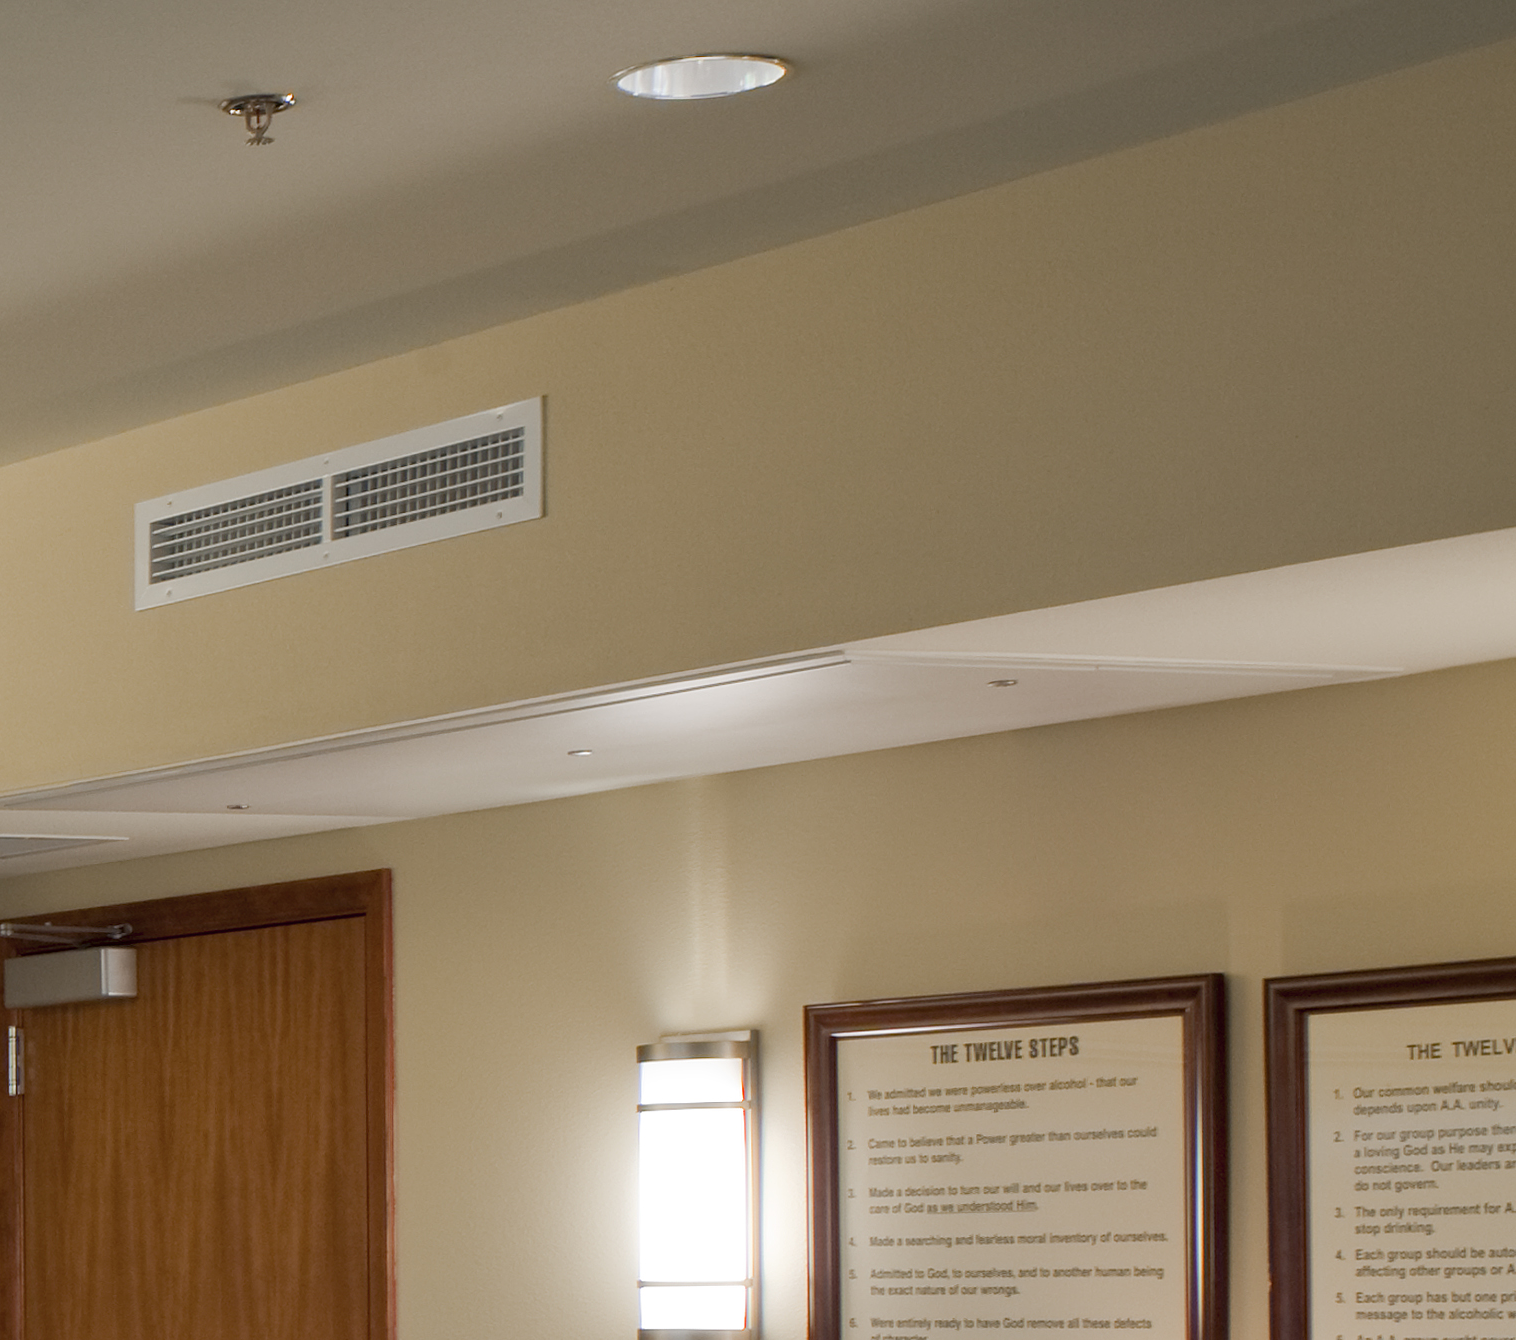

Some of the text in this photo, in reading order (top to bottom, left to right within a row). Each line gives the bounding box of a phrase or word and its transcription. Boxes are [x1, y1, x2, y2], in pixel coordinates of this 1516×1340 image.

[931, 1035, 1080, 1065] THE TWELVE STEPS
[1407, 1037, 1516, 1061] THE TWELV
